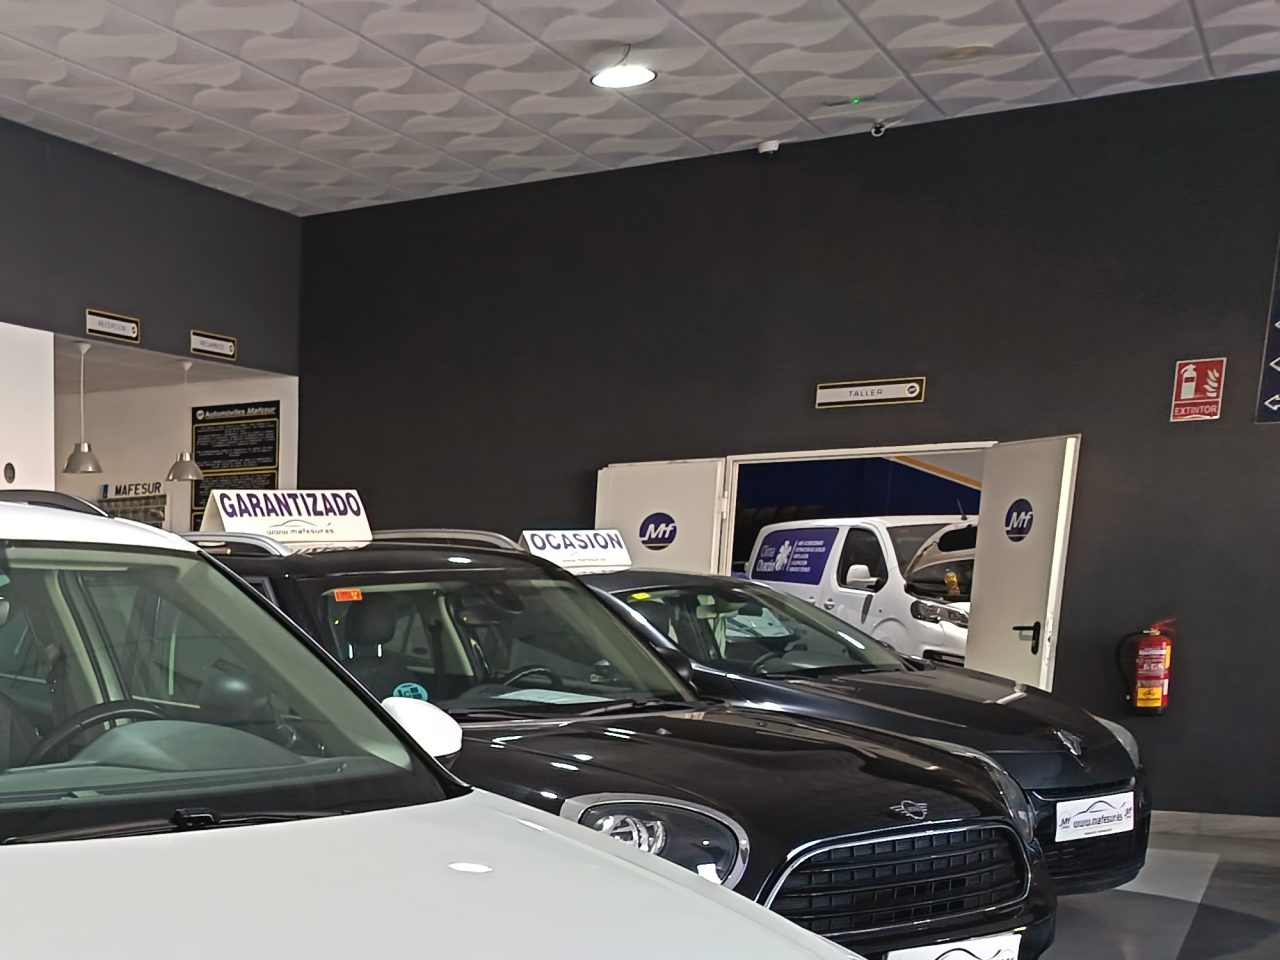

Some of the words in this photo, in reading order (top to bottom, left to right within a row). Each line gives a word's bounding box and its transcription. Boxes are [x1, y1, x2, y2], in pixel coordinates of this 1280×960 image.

[848, 388, 883, 397] TALLER
[1174, 405, 1218, 416] EXTINTOR
[115, 481, 162, 496] MAFESUR
[220, 492, 361, 518] GARANTIZADO
